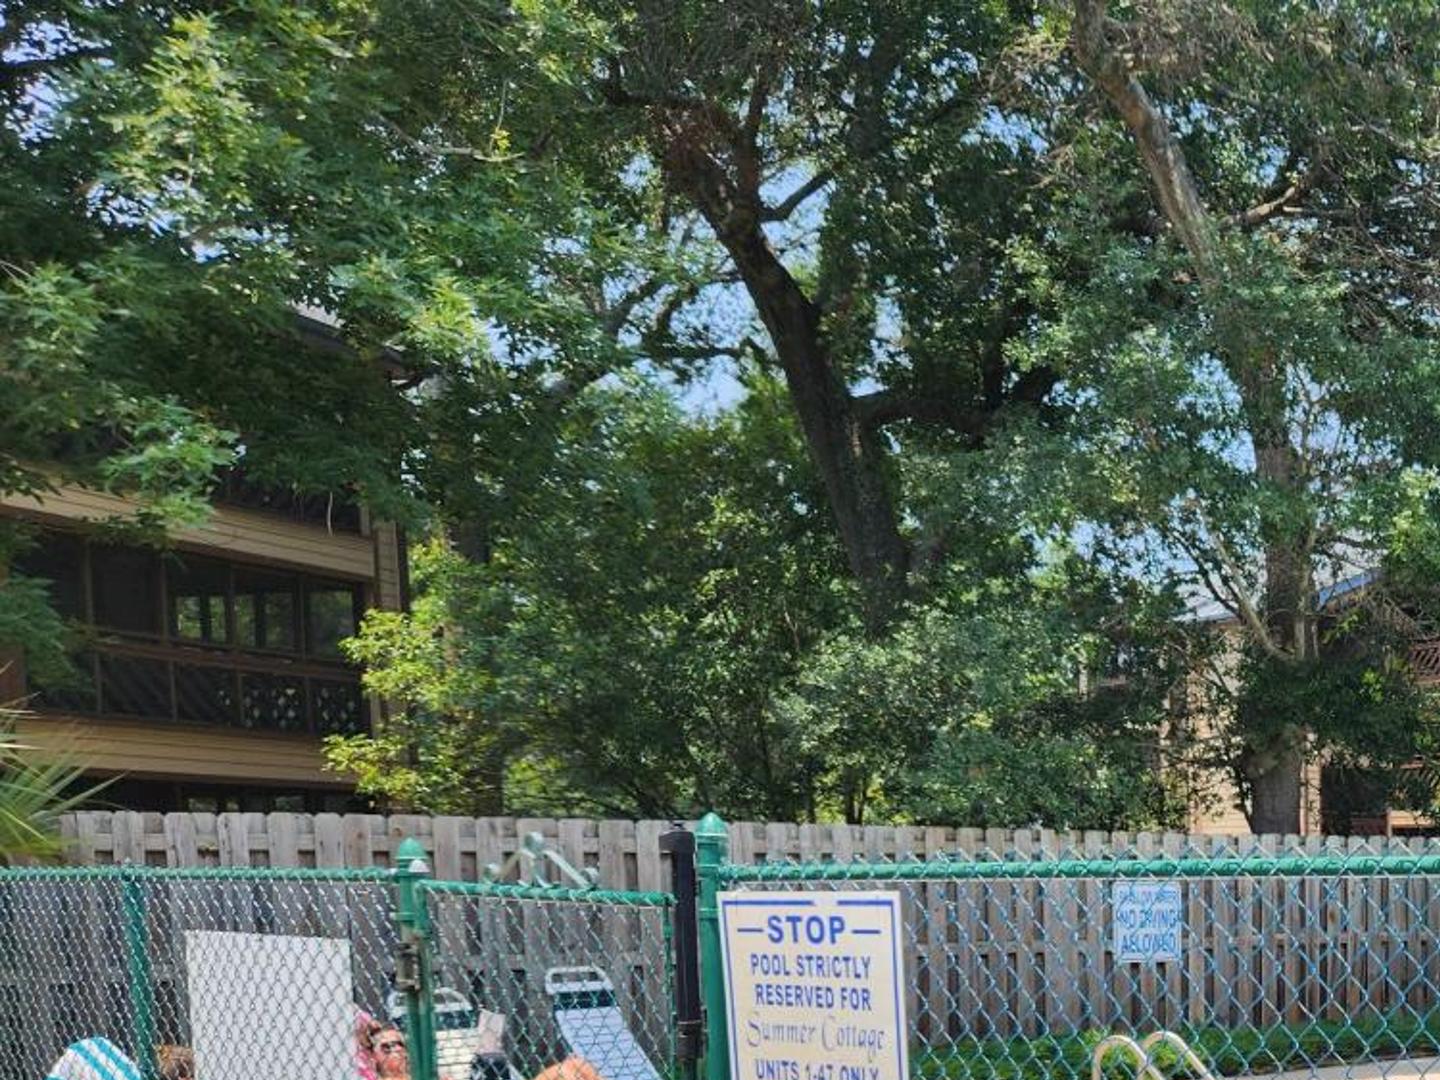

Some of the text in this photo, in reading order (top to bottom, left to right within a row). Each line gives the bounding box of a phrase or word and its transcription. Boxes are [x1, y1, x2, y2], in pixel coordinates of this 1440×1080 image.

[767, 915, 846, 945] STOP
[1119, 908, 1177, 928] NO DIVING
[750, 954, 871, 979] POOL STRICTLY
[755, 984, 872, 1011] RESERVED FOR
[746, 1011, 885, 1063] Summer Cottage
